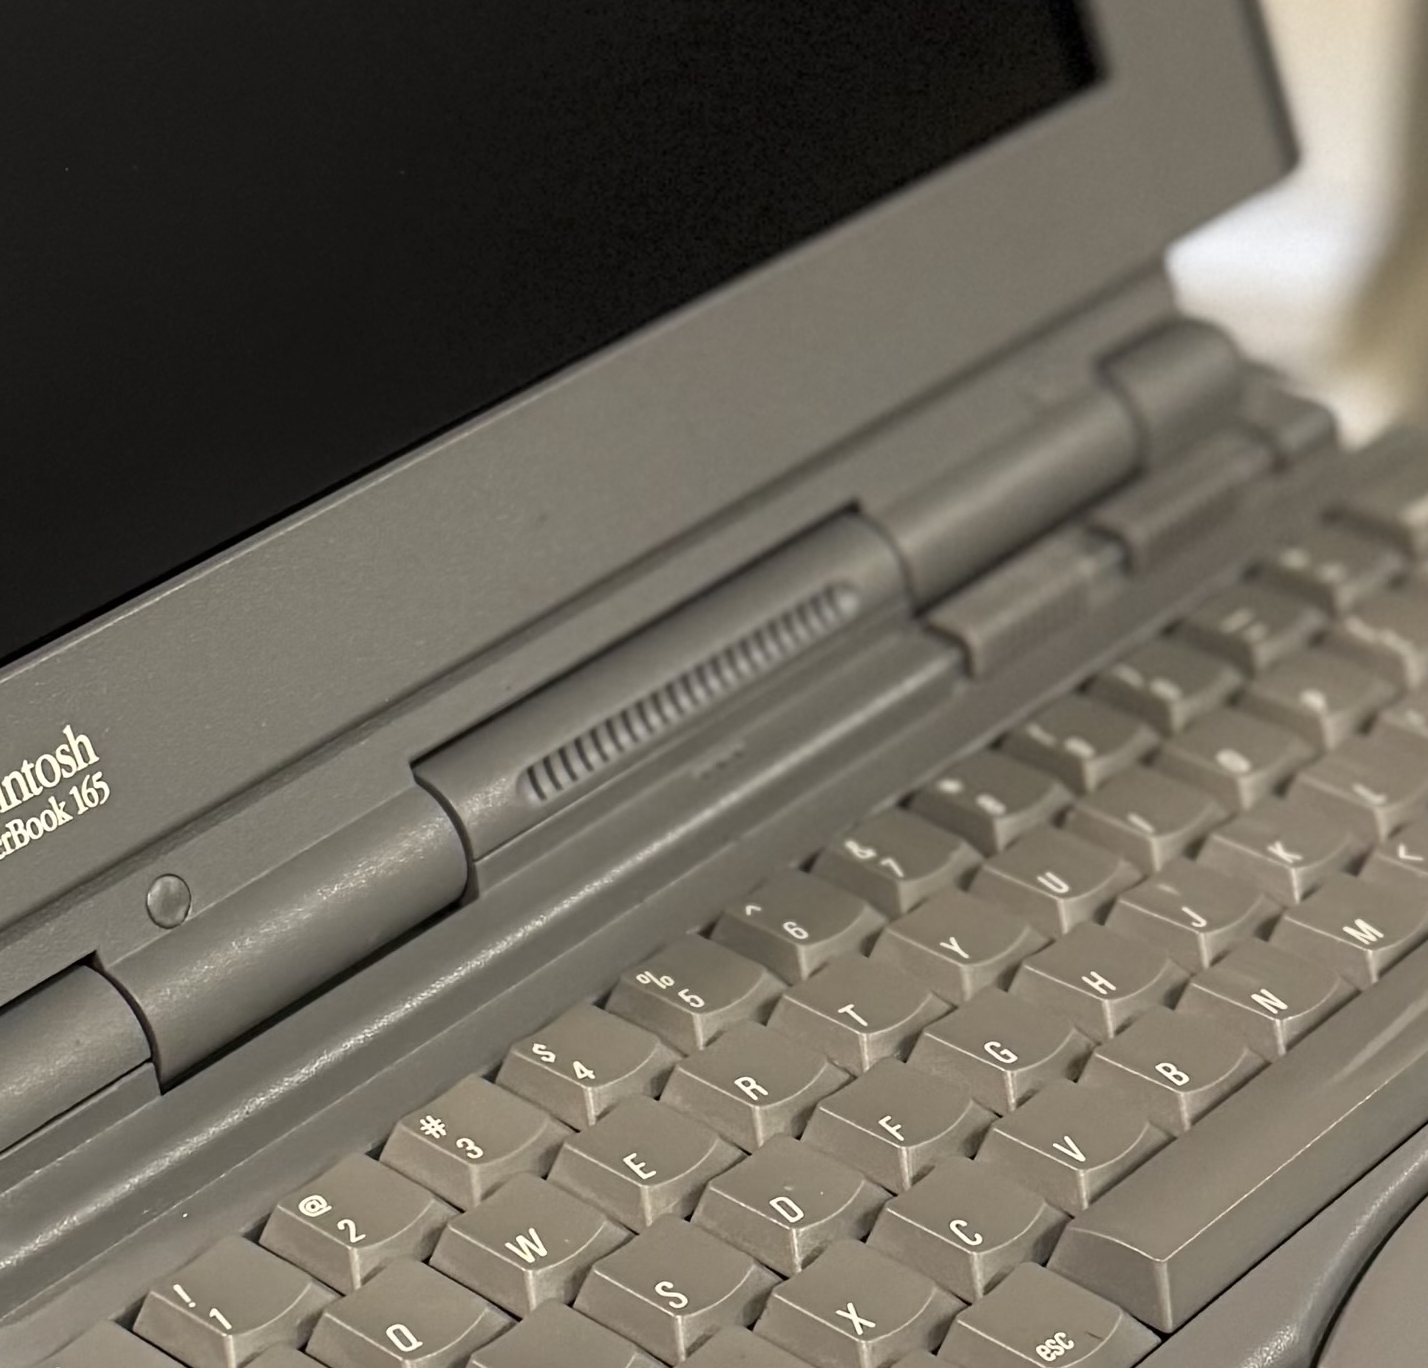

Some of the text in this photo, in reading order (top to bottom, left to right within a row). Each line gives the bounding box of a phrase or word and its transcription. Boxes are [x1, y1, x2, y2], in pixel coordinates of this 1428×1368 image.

[69, 771, 111, 815] 165
[1268, 841, 1302, 864] K
[1037, 871, 1070, 894] U
[782, 921, 810, 940] 6
[1180, 906, 1208, 929] J
[1342, 917, 1384, 945] M
[939, 936, 971, 960] Y
[635, 970, 705, 1009] % 5
[1080, 971, 1117, 995] H
[1250, 987, 1289, 1015] N
[837, 1003, 869, 1028] T
[983, 1041, 1019, 1065] G
[572, 1060, 597, 1081] 4
[1155, 1061, 1191, 1087] B
[734, 1075, 770, 1102] R
[418, 1114, 485, 1160] # 3
[877, 1114, 906, 1143] F
[1052, 1135, 1087, 1163] V
[623, 1151, 658, 1181] E
[297, 1193, 367, 1244] @ 2
[768, 1196, 805, 1224] D
[503, 1226, 549, 1264] W
[948, 1218, 984, 1247] C
[653, 1280, 689, 1310] S
[208, 1307, 232, 1330] 1
[834, 1301, 877, 1336] X
[384, 1322, 424, 1353] Q
[1034, 1331, 1076, 1363] esc
